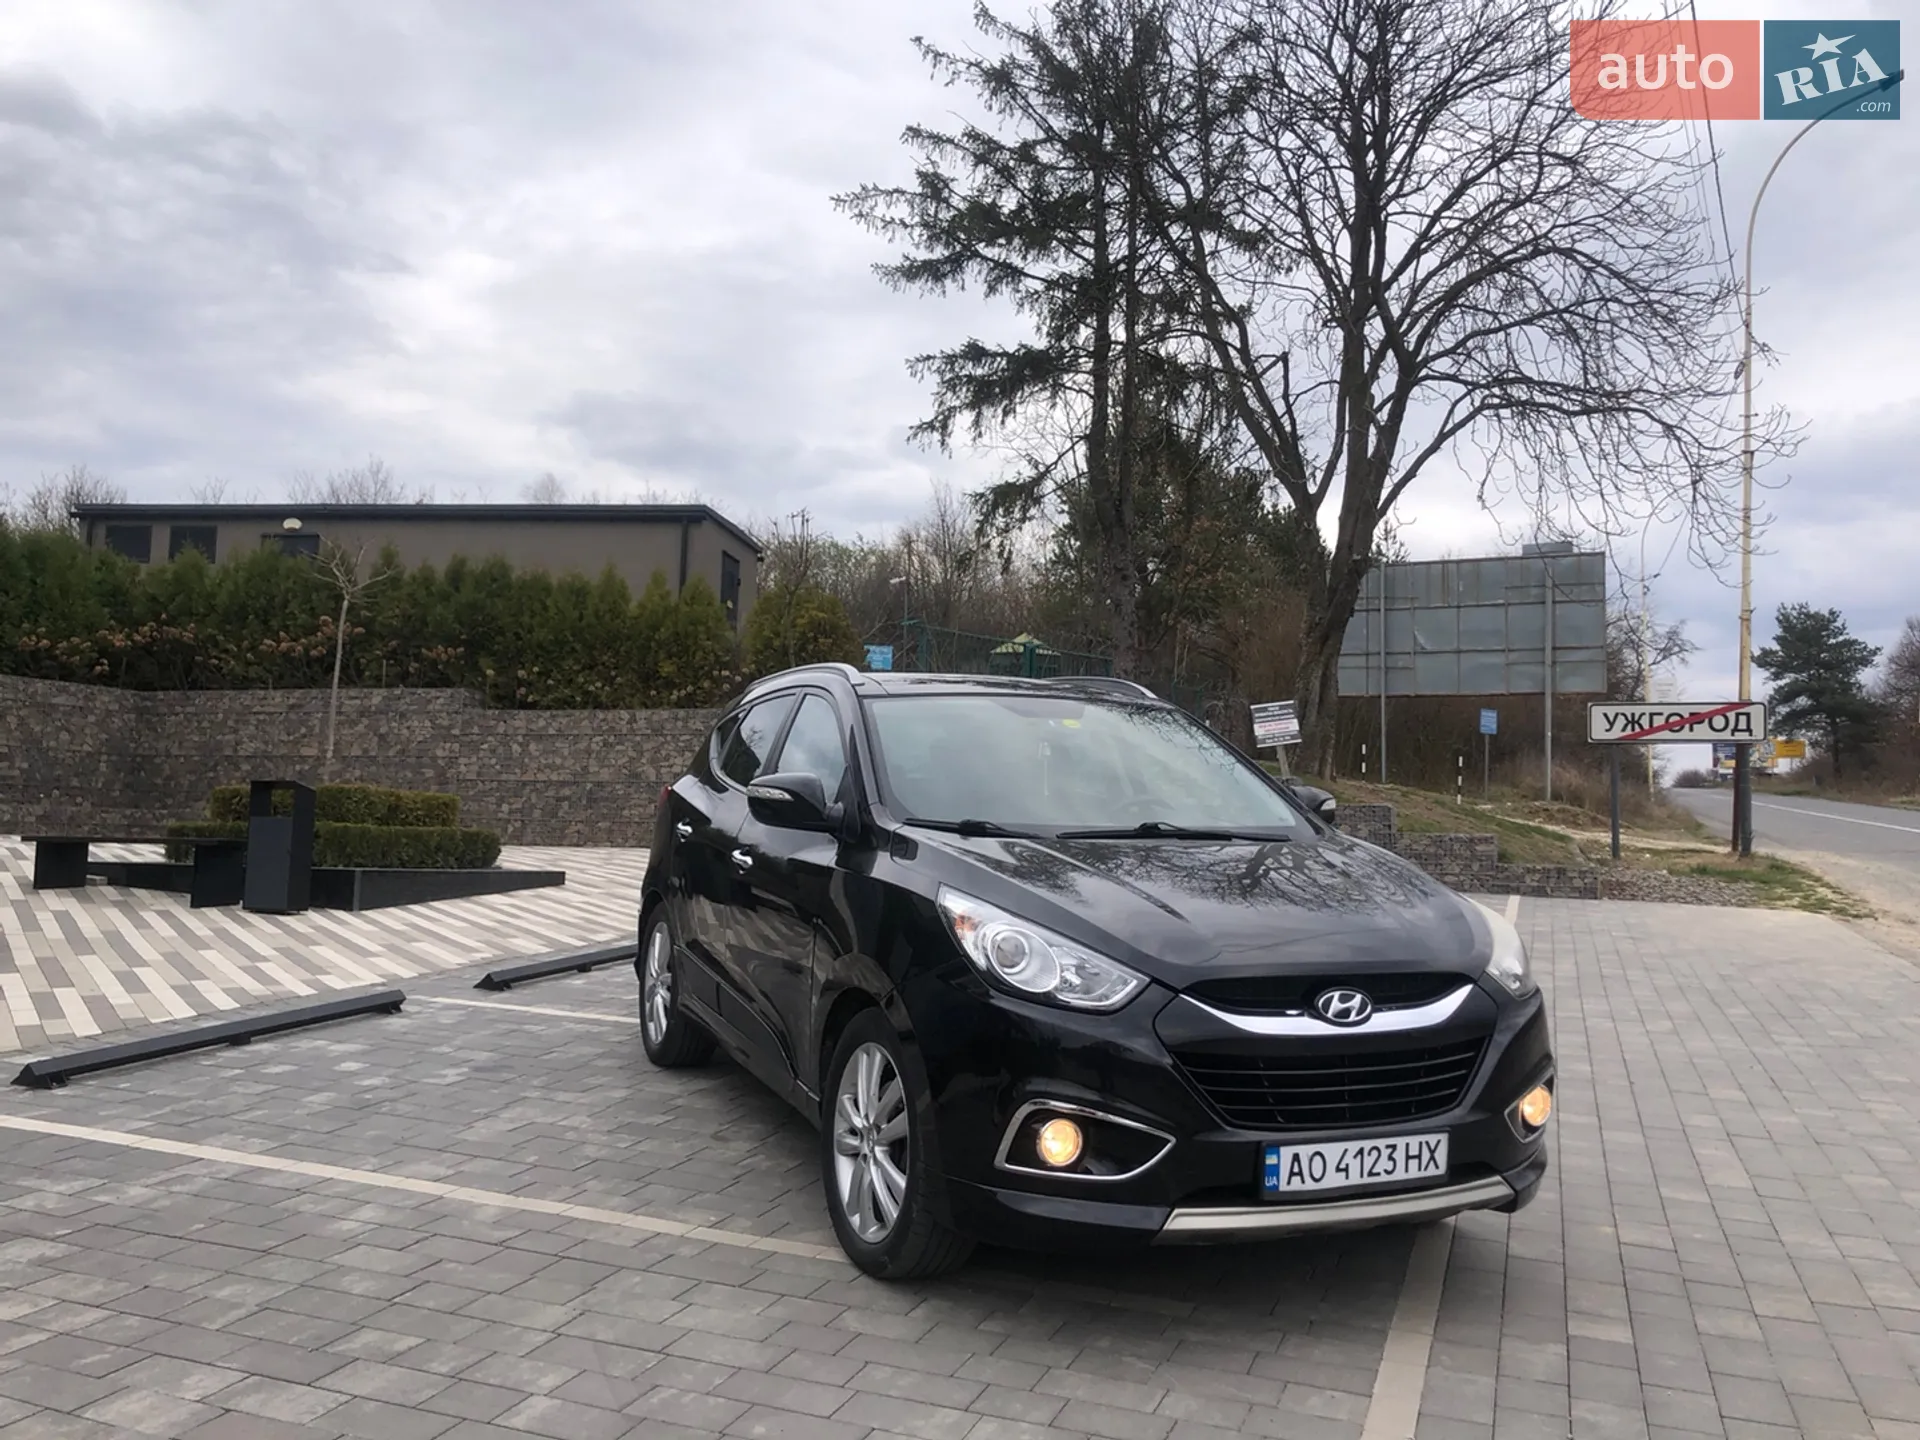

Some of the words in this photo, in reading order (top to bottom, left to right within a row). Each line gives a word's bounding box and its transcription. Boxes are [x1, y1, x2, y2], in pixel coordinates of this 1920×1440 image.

[1602, 712, 1754, 736] УЖГОРОД
[1286, 1150, 1327, 1186] AO
[1335, 1144, 1398, 1180] 4123
[1404, 1139, 1442, 1174] HX
[1265, 1176, 1278, 1186] UA
